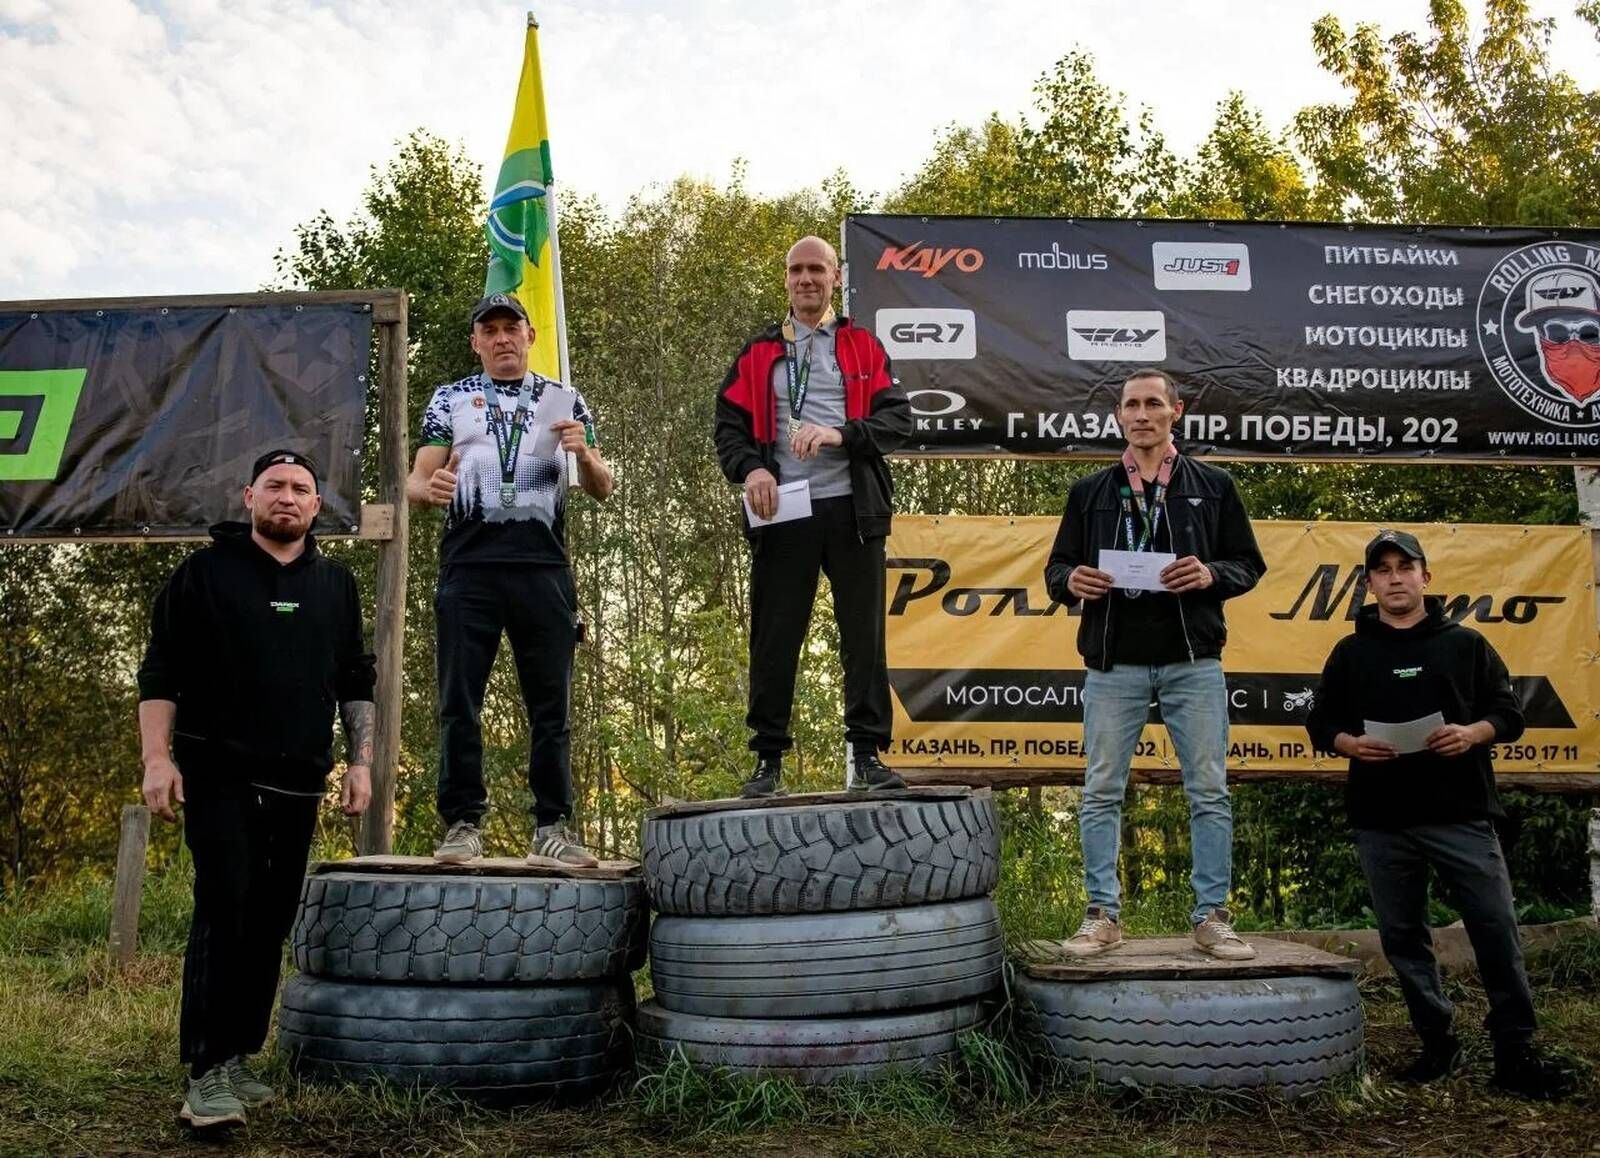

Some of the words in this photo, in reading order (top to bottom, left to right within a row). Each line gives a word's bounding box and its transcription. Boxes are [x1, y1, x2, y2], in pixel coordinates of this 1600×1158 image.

[876, 240, 985, 278] KAYO
[1324, 244, 1460, 266] ПИТБАЙКИ
[1490, 245, 1571, 294] ROLLING
[1308, 284, 1465, 310] СНЕГОХОДЫ
[890, 323, 965, 344] GR7
[1305, 325, 1469, 350] МОТОЦИКЛЫ
[1276, 367, 1472, 393] КВАДРОЦИКЛЫ
[1492, 355, 1570, 422] МОТОТЕХНИКА
[917, 418, 983, 431] KLEY
[1007, 413, 1028, 438] Г.
[1184, 414, 1231, 441] ПР.
[1241, 415, 1393, 448] ПОБЕДЫ,
[1402, 417, 1459, 443] 202
[1488, 430, 1600, 446] WWW.ROLLING
[1269, 564, 1567, 625] Мто
[902, 739, 985, 757] КАЗАНЬ,
[990, 740, 1018, 756] ПР.
[1135, 742, 1156, 756] 02
[1279, 744, 1307, 759] ПР.
[1503, 746, 1536, 760] 250
[1542, 746, 1560, 760] 17
[1563, 746, 1578, 760] 11
